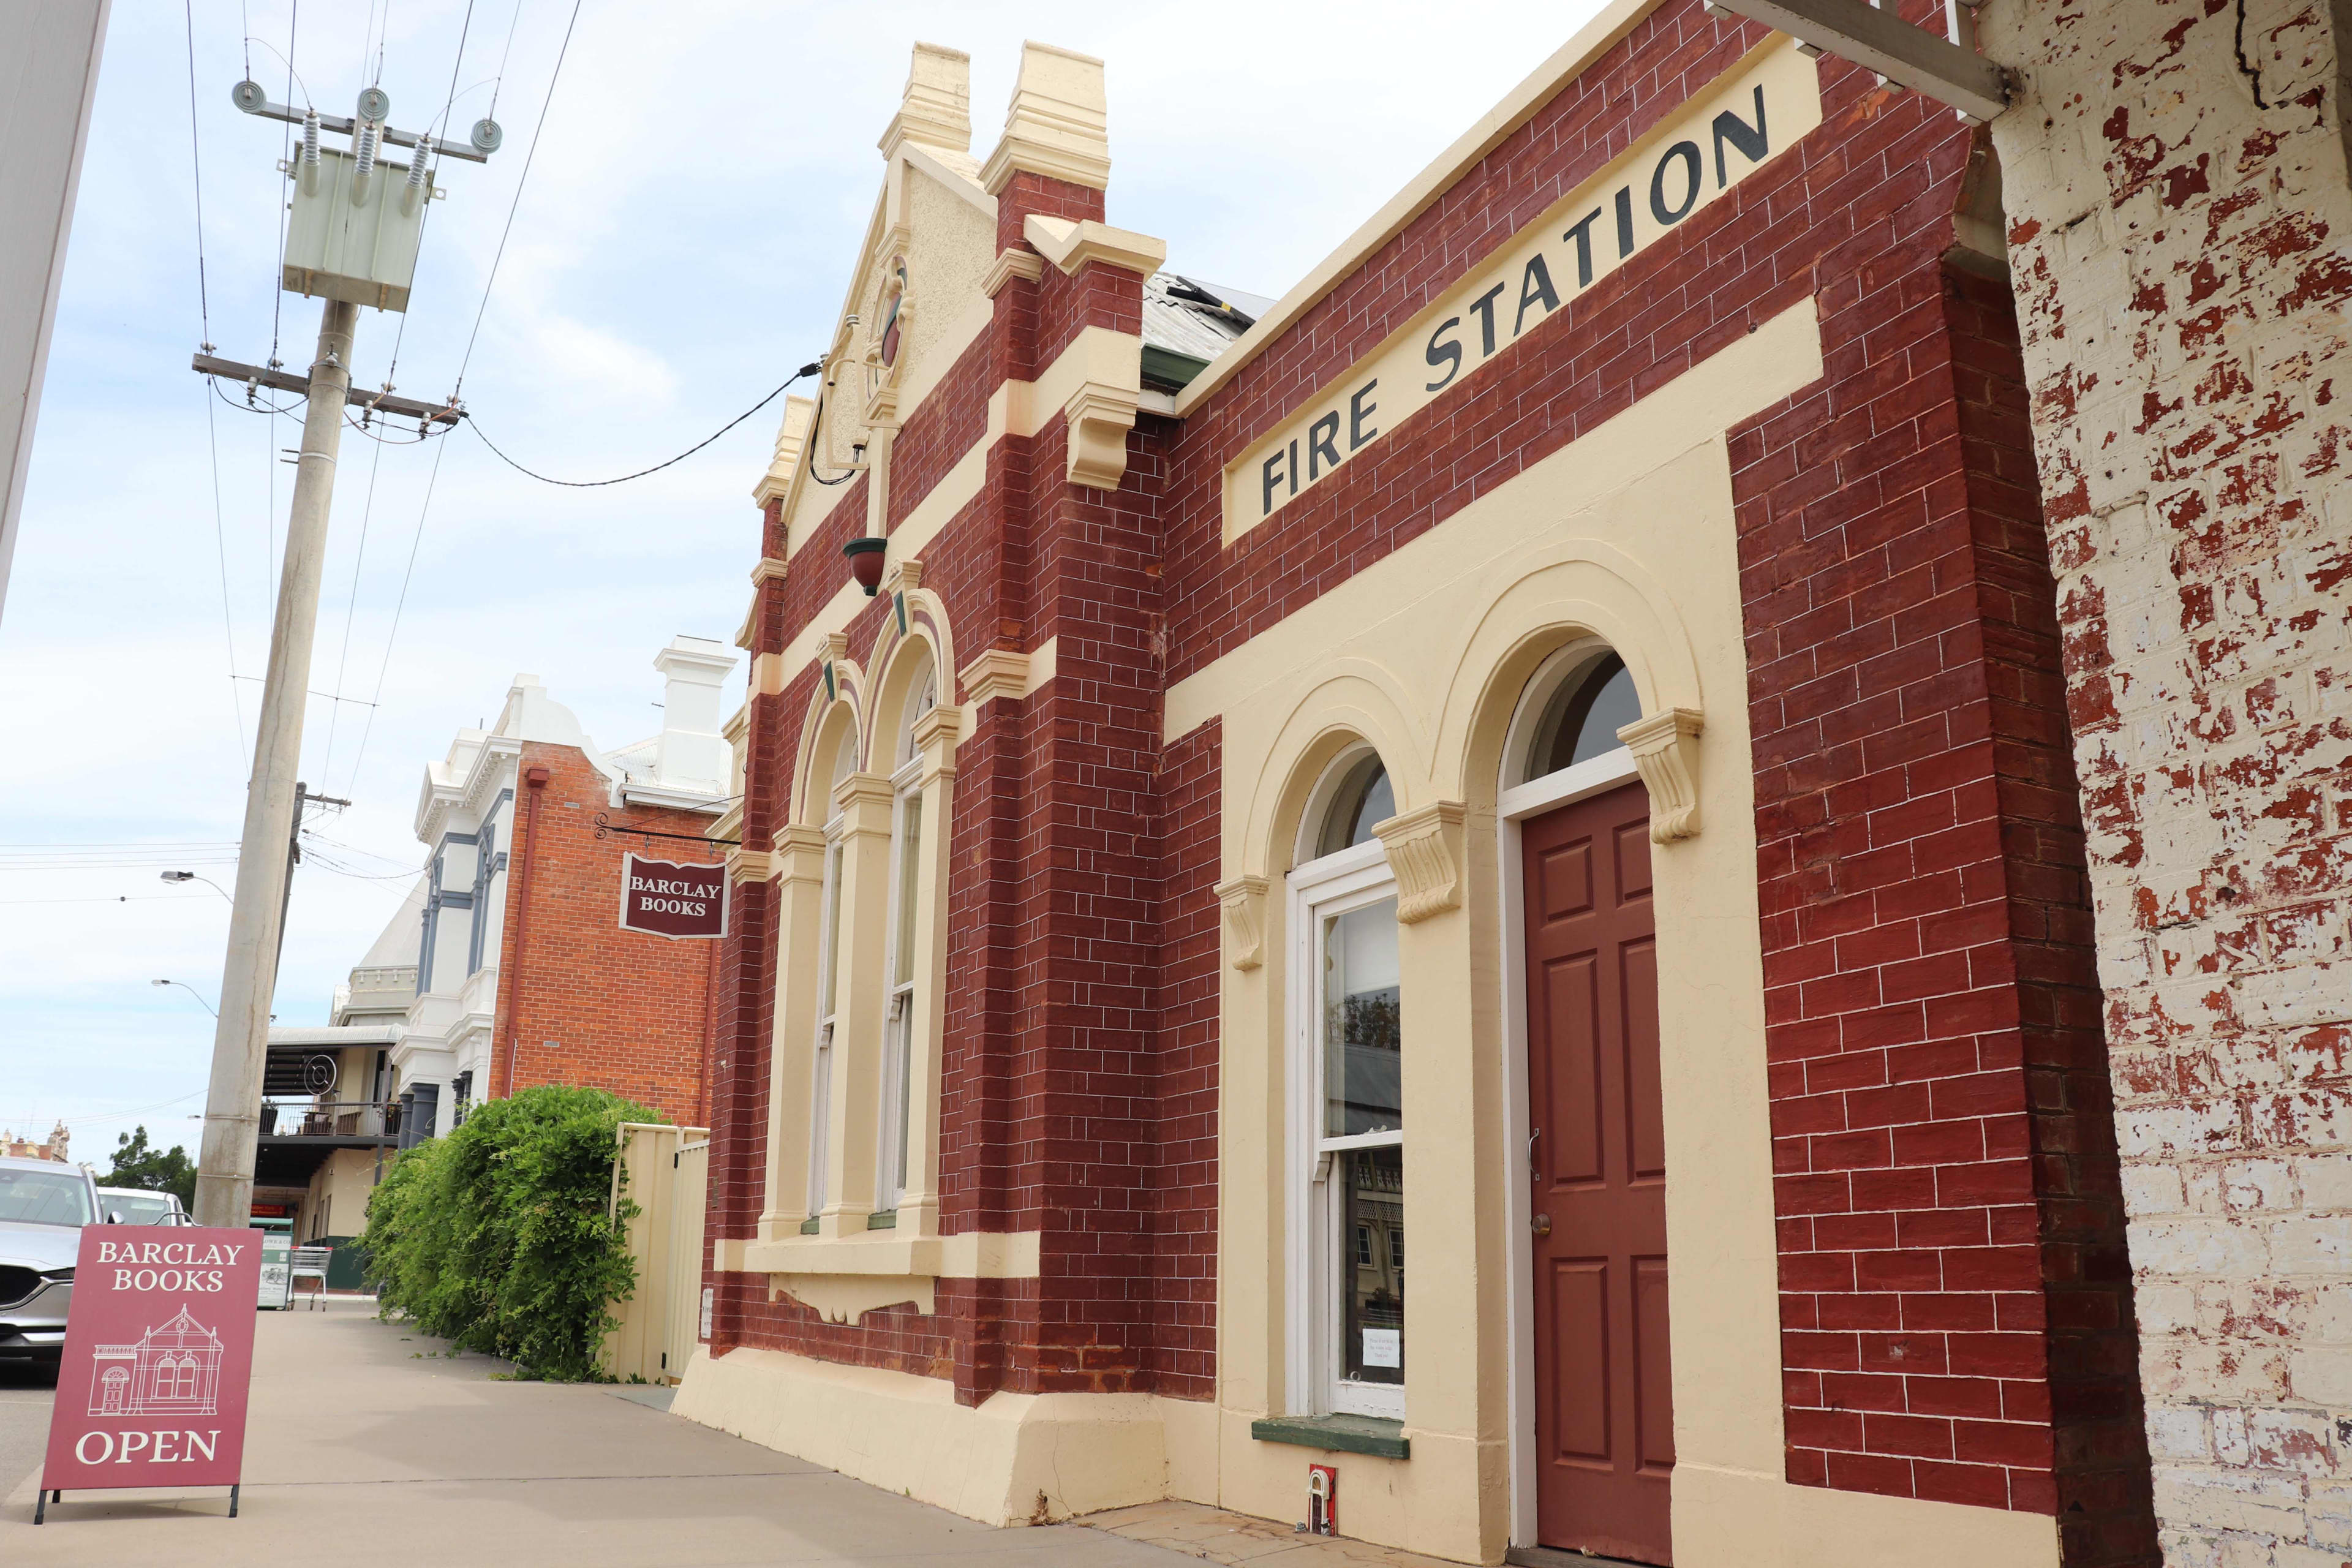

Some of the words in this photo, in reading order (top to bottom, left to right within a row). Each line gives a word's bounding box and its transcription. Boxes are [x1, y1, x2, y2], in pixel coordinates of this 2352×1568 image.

[1262, 377, 1378, 516] FIRE
[1425, 83, 1770, 393] STATION
[630, 876, 722, 899] BARCLAY
[639, 896, 706, 917] BOOKS
[96, 1242, 244, 1265] BARCLAY
[111, 1269, 223, 1292] BOOKS
[75, 1430, 221, 1465] OPEN
